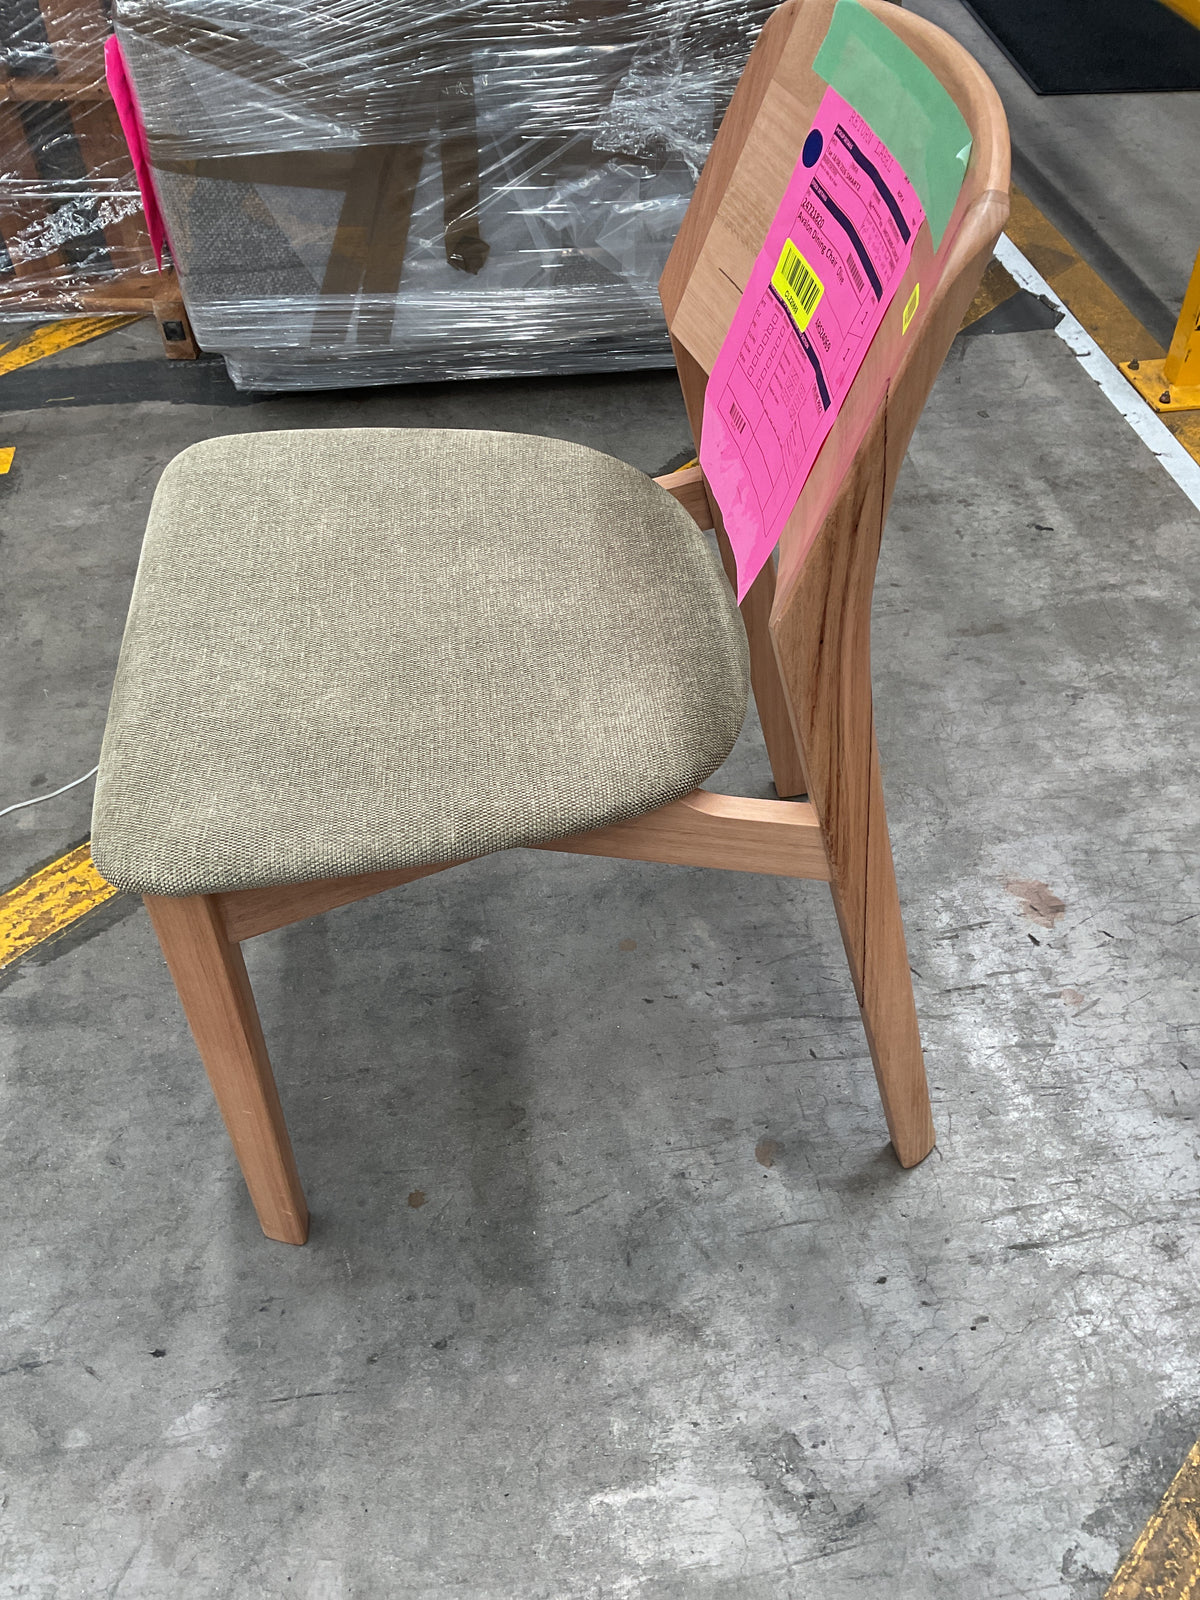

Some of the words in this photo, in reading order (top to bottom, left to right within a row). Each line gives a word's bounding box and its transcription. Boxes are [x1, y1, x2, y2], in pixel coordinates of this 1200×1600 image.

[797, 210, 813, 235] Avalon
[811, 229, 827, 255] Dining
[824, 247, 838, 267] Chair
